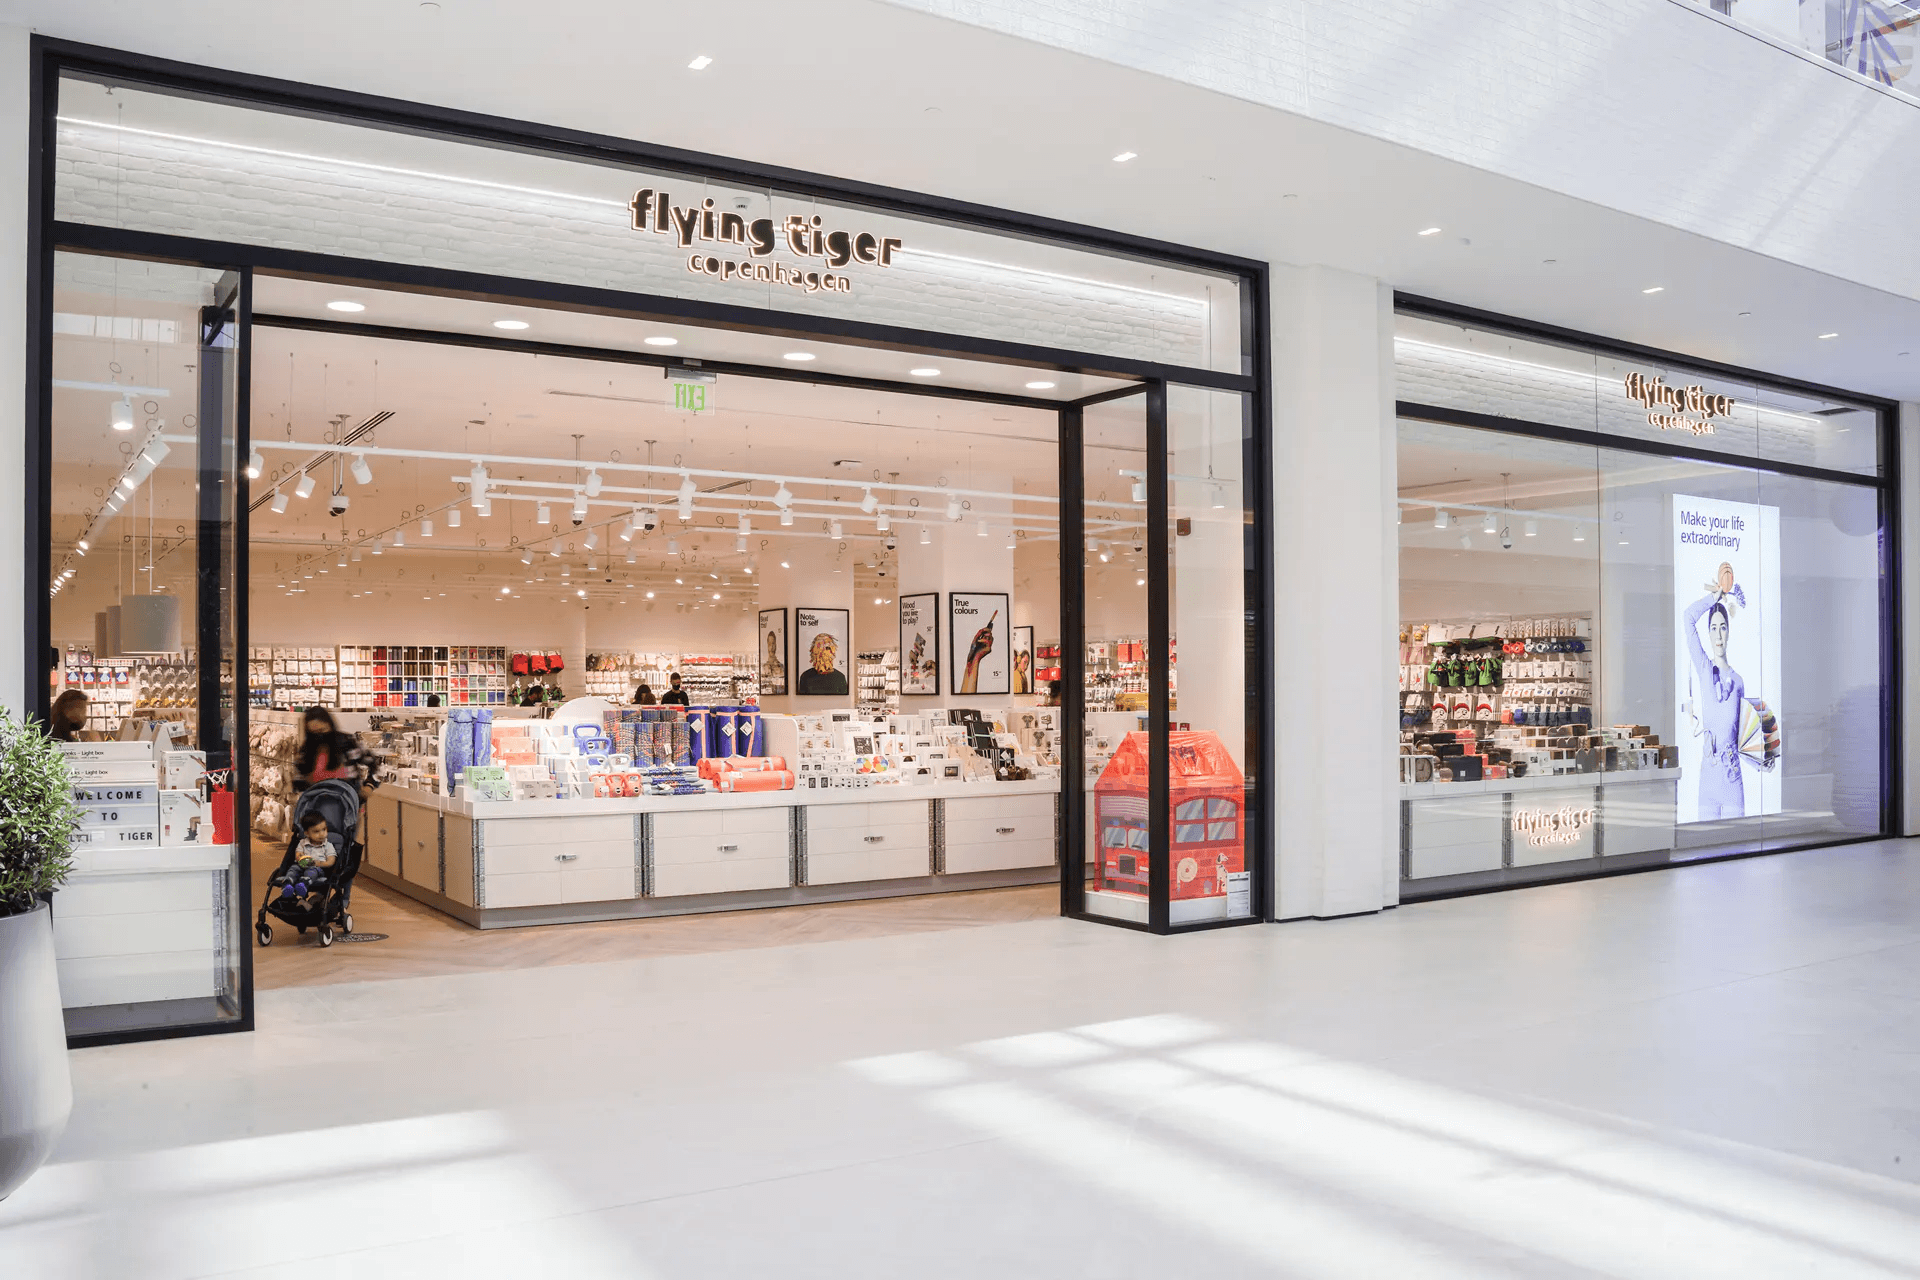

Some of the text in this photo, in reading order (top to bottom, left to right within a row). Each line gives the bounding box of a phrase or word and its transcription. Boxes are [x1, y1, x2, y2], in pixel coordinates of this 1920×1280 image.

[628, 187, 902, 269] flying tiger
[687, 254, 851, 293] copenhagen
[1625, 372, 1735, 419] flying tiger
[1648, 413, 1716, 436] copenhagen
[1680, 511, 1745, 532] Make your life
[1680, 531, 1741, 551] extraordinary
[954, 599, 969, 607] True
[954, 607, 979, 615] colours
[101, 812, 118, 821] TO
[1513, 805, 1597, 833] flying tiger
[119, 832, 153, 841] TIGER
